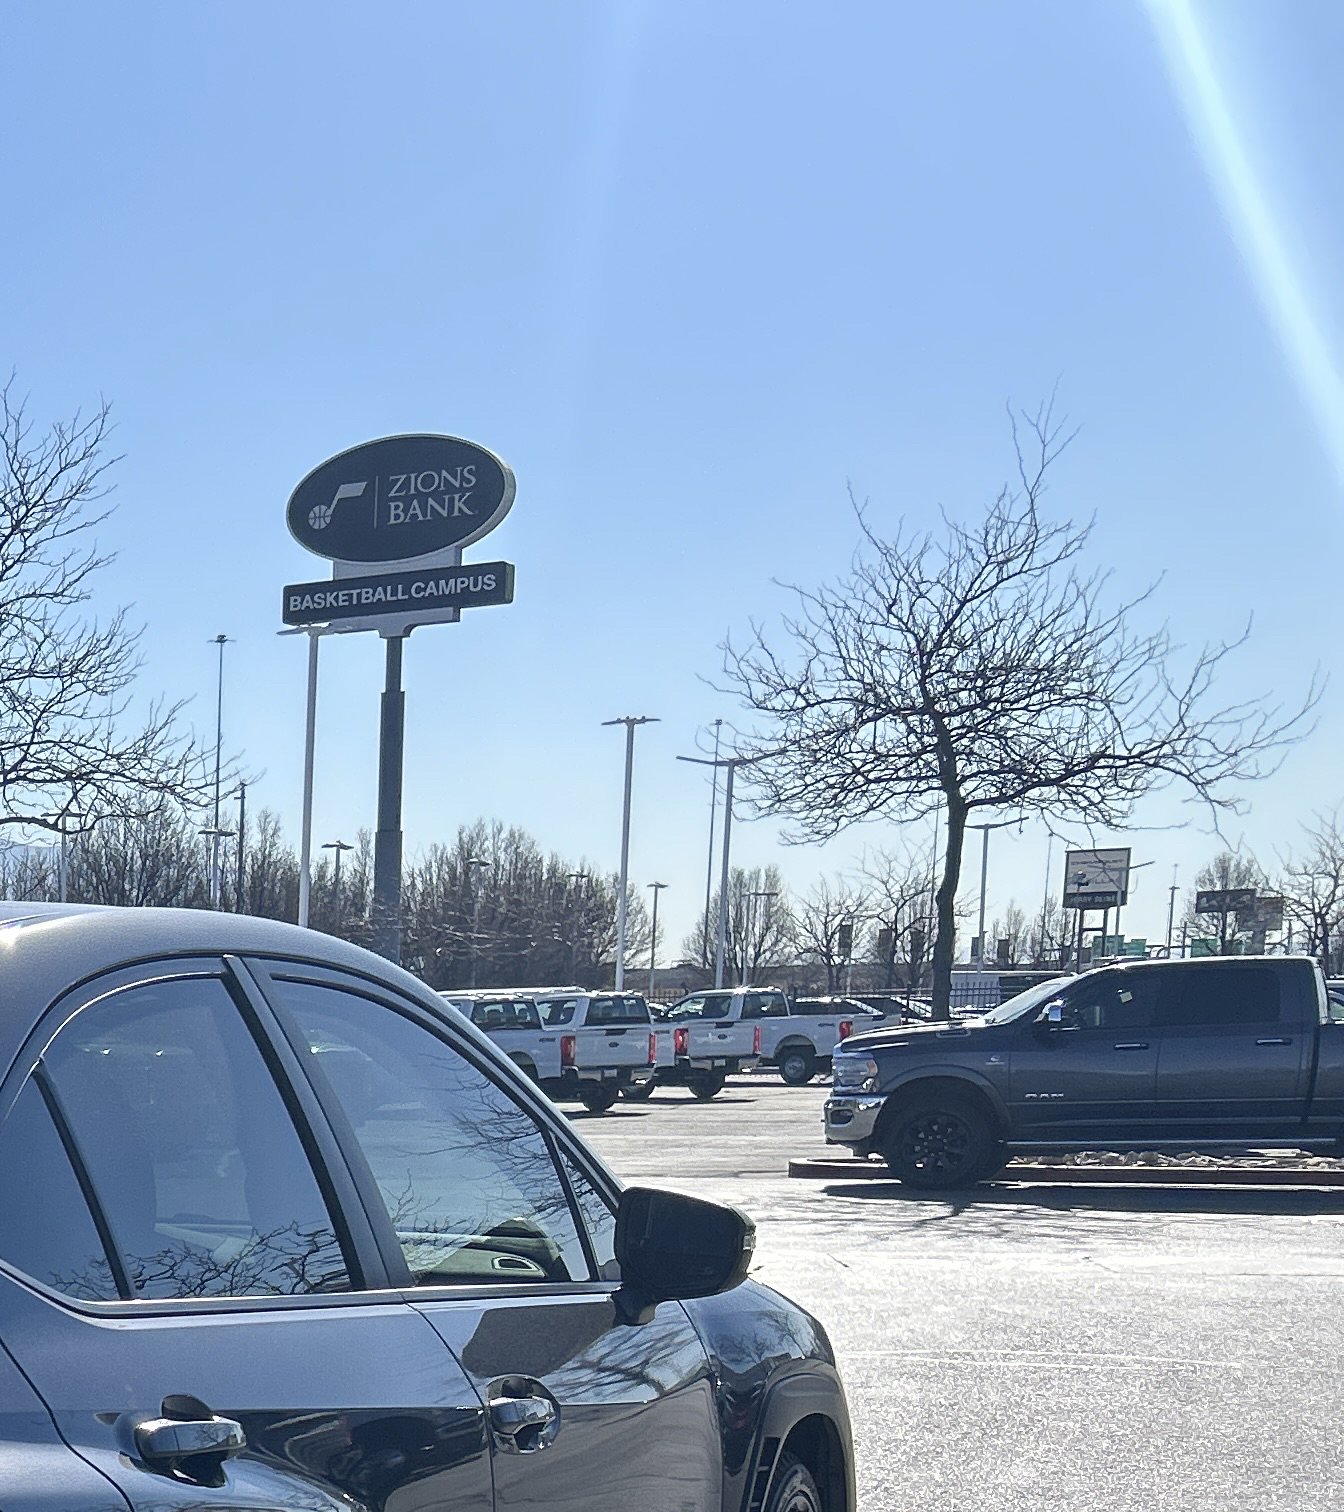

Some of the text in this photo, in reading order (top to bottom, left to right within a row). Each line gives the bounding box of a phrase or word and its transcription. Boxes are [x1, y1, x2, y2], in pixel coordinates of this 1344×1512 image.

[388, 465, 477, 497] ZIONS
[387, 491, 474, 526] BANK
[289, 574, 497, 612] BASKETBALL CAMPUS
